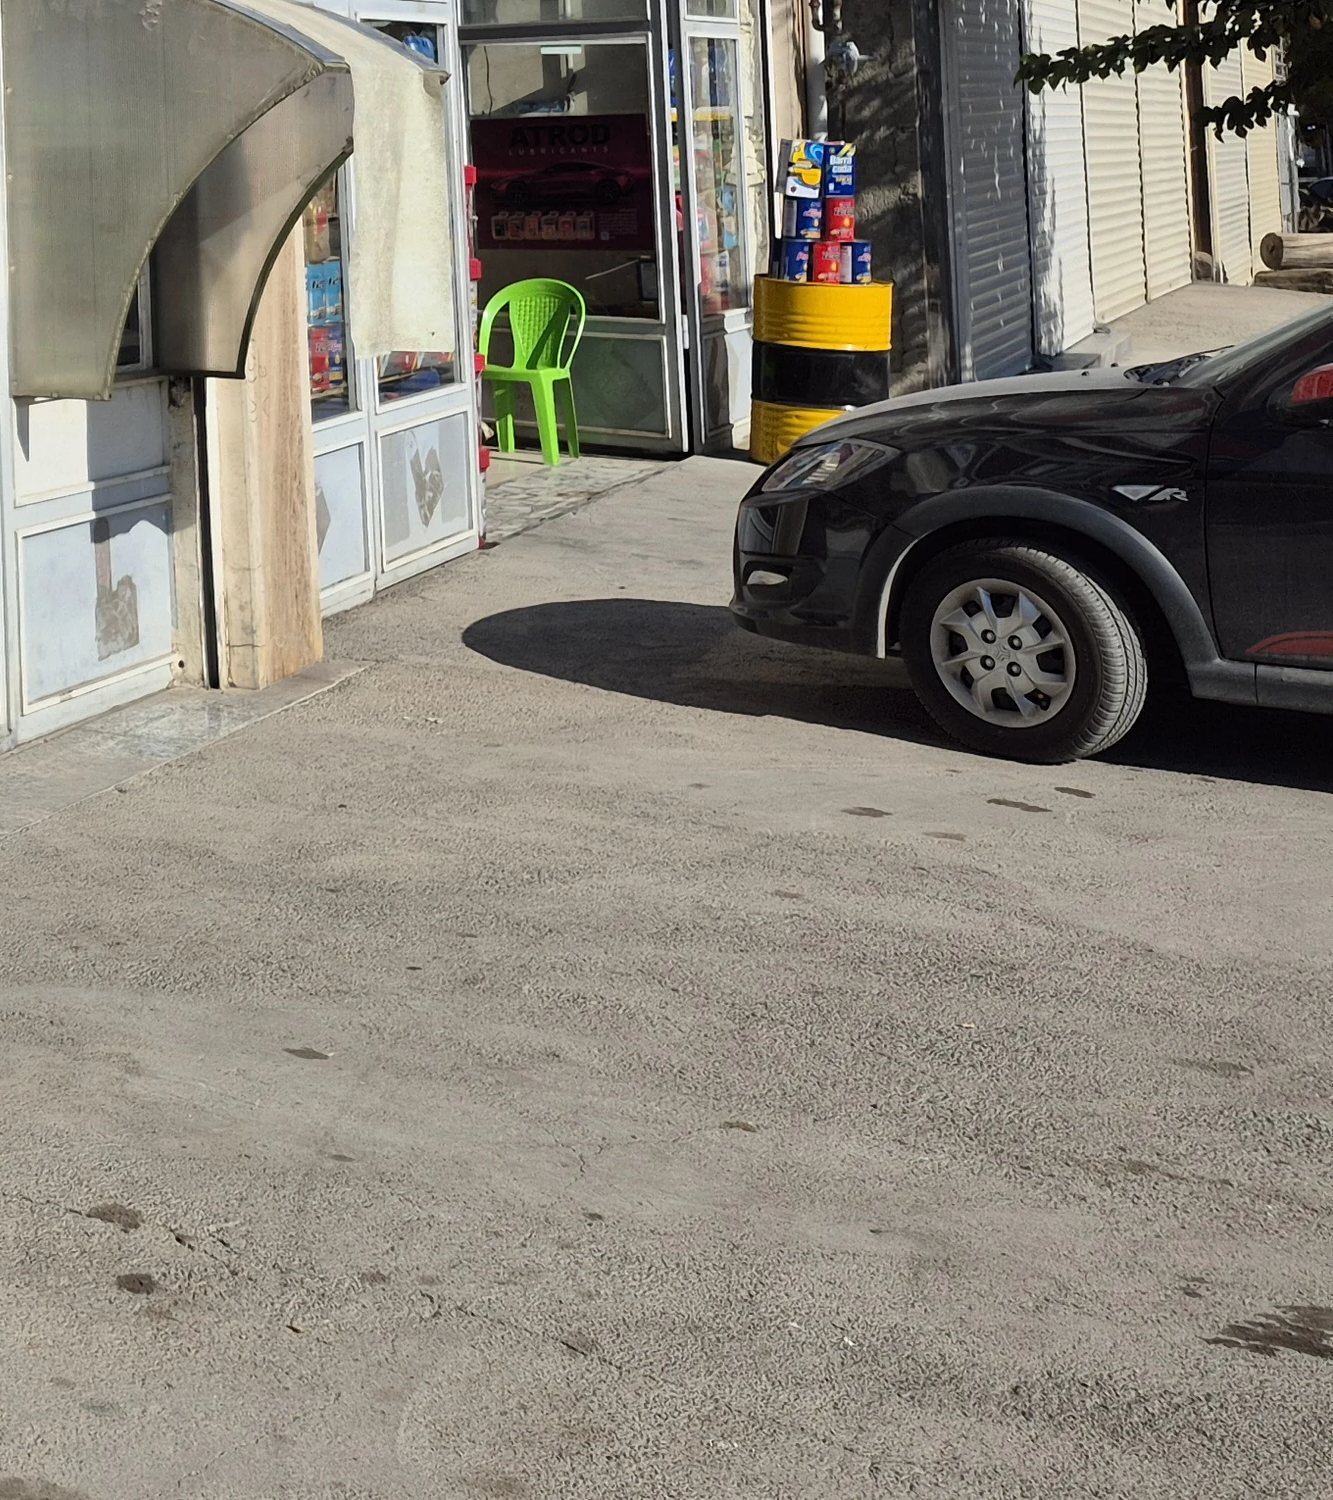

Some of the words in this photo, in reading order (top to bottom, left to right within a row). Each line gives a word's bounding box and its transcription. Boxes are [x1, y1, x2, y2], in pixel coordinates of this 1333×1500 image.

[510, 124, 610, 147] ATROD
[508, 147, 609, 156] LUBRICANTS
[830, 155, 852, 165] Barra
